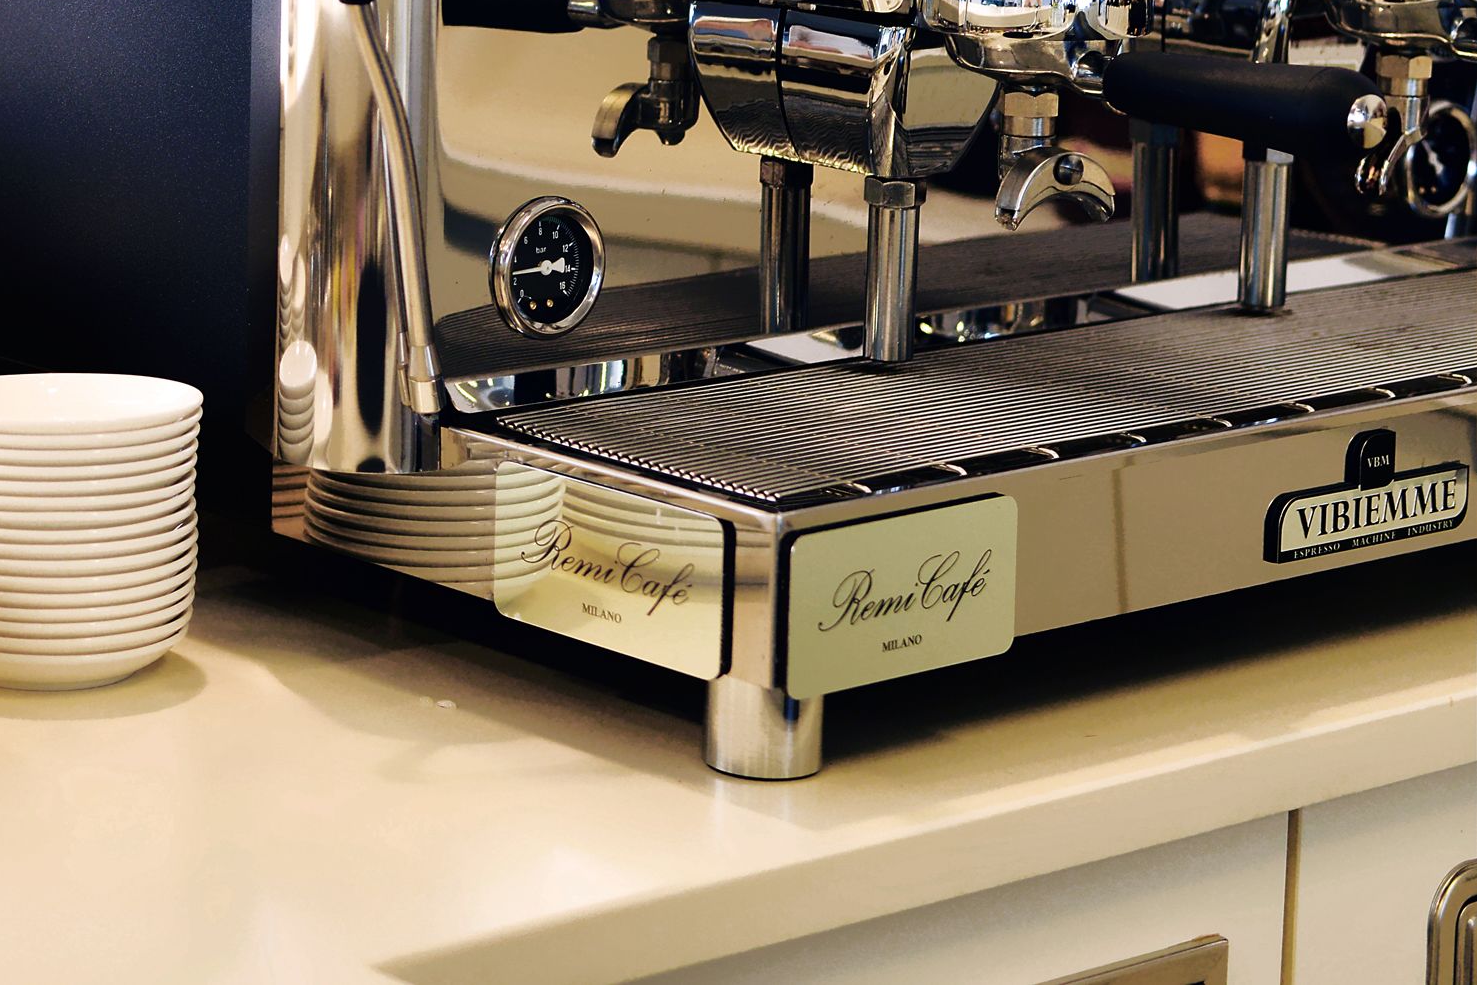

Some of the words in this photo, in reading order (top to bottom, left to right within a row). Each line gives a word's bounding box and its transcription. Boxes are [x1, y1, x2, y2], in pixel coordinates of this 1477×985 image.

[538, 227, 543, 236] 8
[552, 230, 559, 240] 10
[535, 246, 547, 254] bar
[562, 243, 570, 253] 12
[564, 264, 571, 273] 14
[512, 277, 518, 286] 2
[1367, 454, 1390, 468] VBM
[1296, 479, 1457, 540] VIBIEMME
[1293, 542, 1341, 559] ESPRESSO
[1352, 531, 1397, 548] MACHINE
[1407, 519, 1455, 537] INDUSTRY
[521, 519, 617, 584] Remi
[616, 542, 695, 616] Café
[817, 568, 919, 632] Remi
[917, 548, 992, 622] Café
[582, 602, 622, 624] MILANO
[881, 634, 923, 653] MILANO
